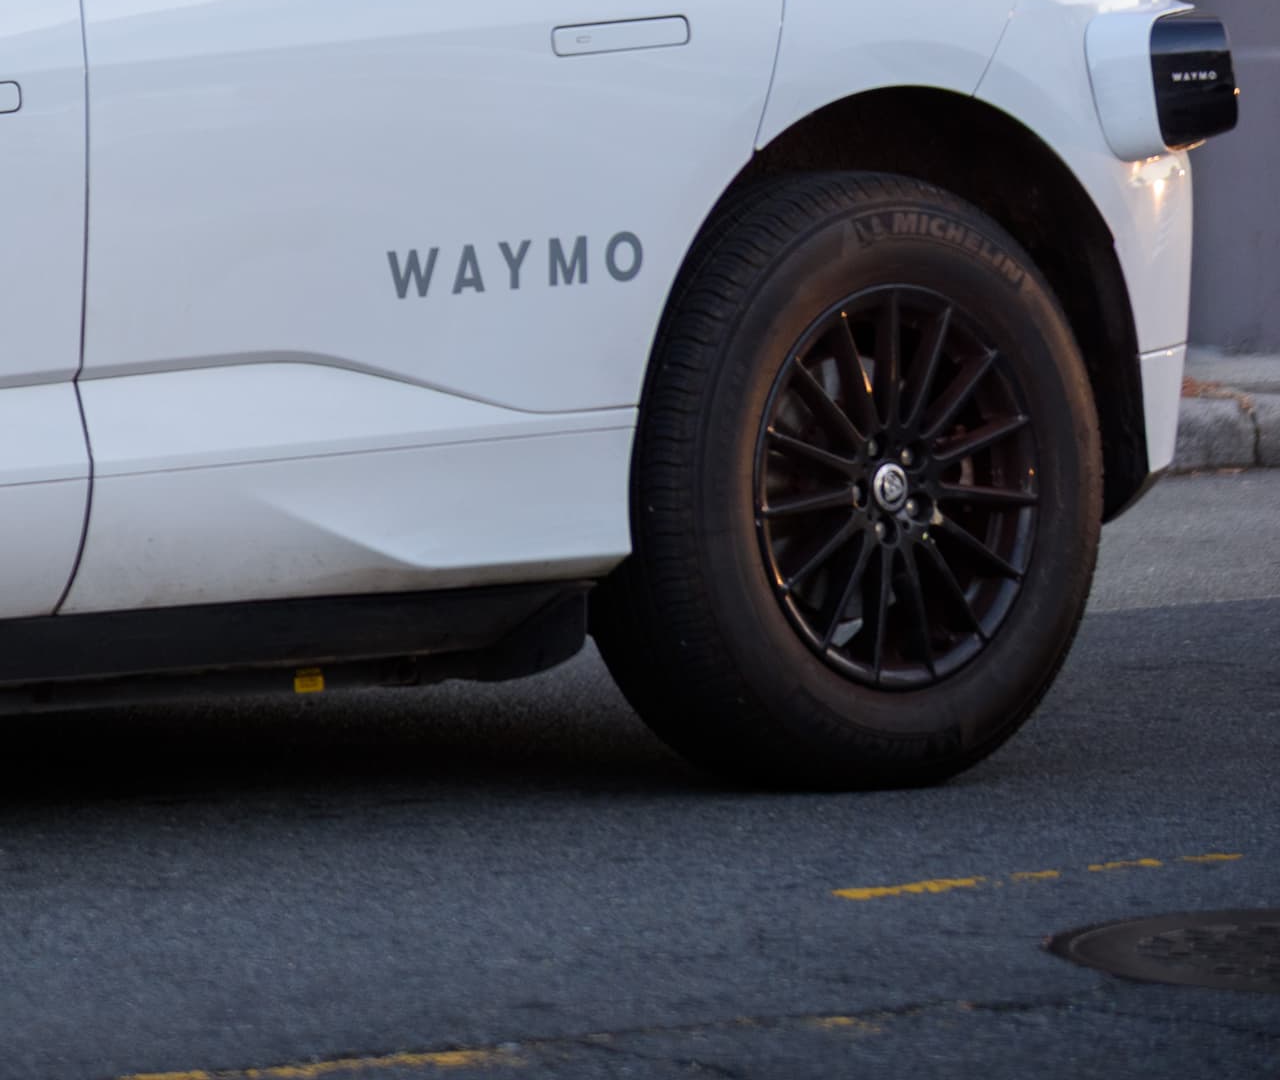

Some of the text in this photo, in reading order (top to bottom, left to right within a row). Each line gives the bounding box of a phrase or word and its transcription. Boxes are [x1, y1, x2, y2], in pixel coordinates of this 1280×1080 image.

[1171, 70, 1218, 82] WAYMO
[386, 231, 644, 299] WAYMO
[892, 213, 1024, 284] MICHELIN
